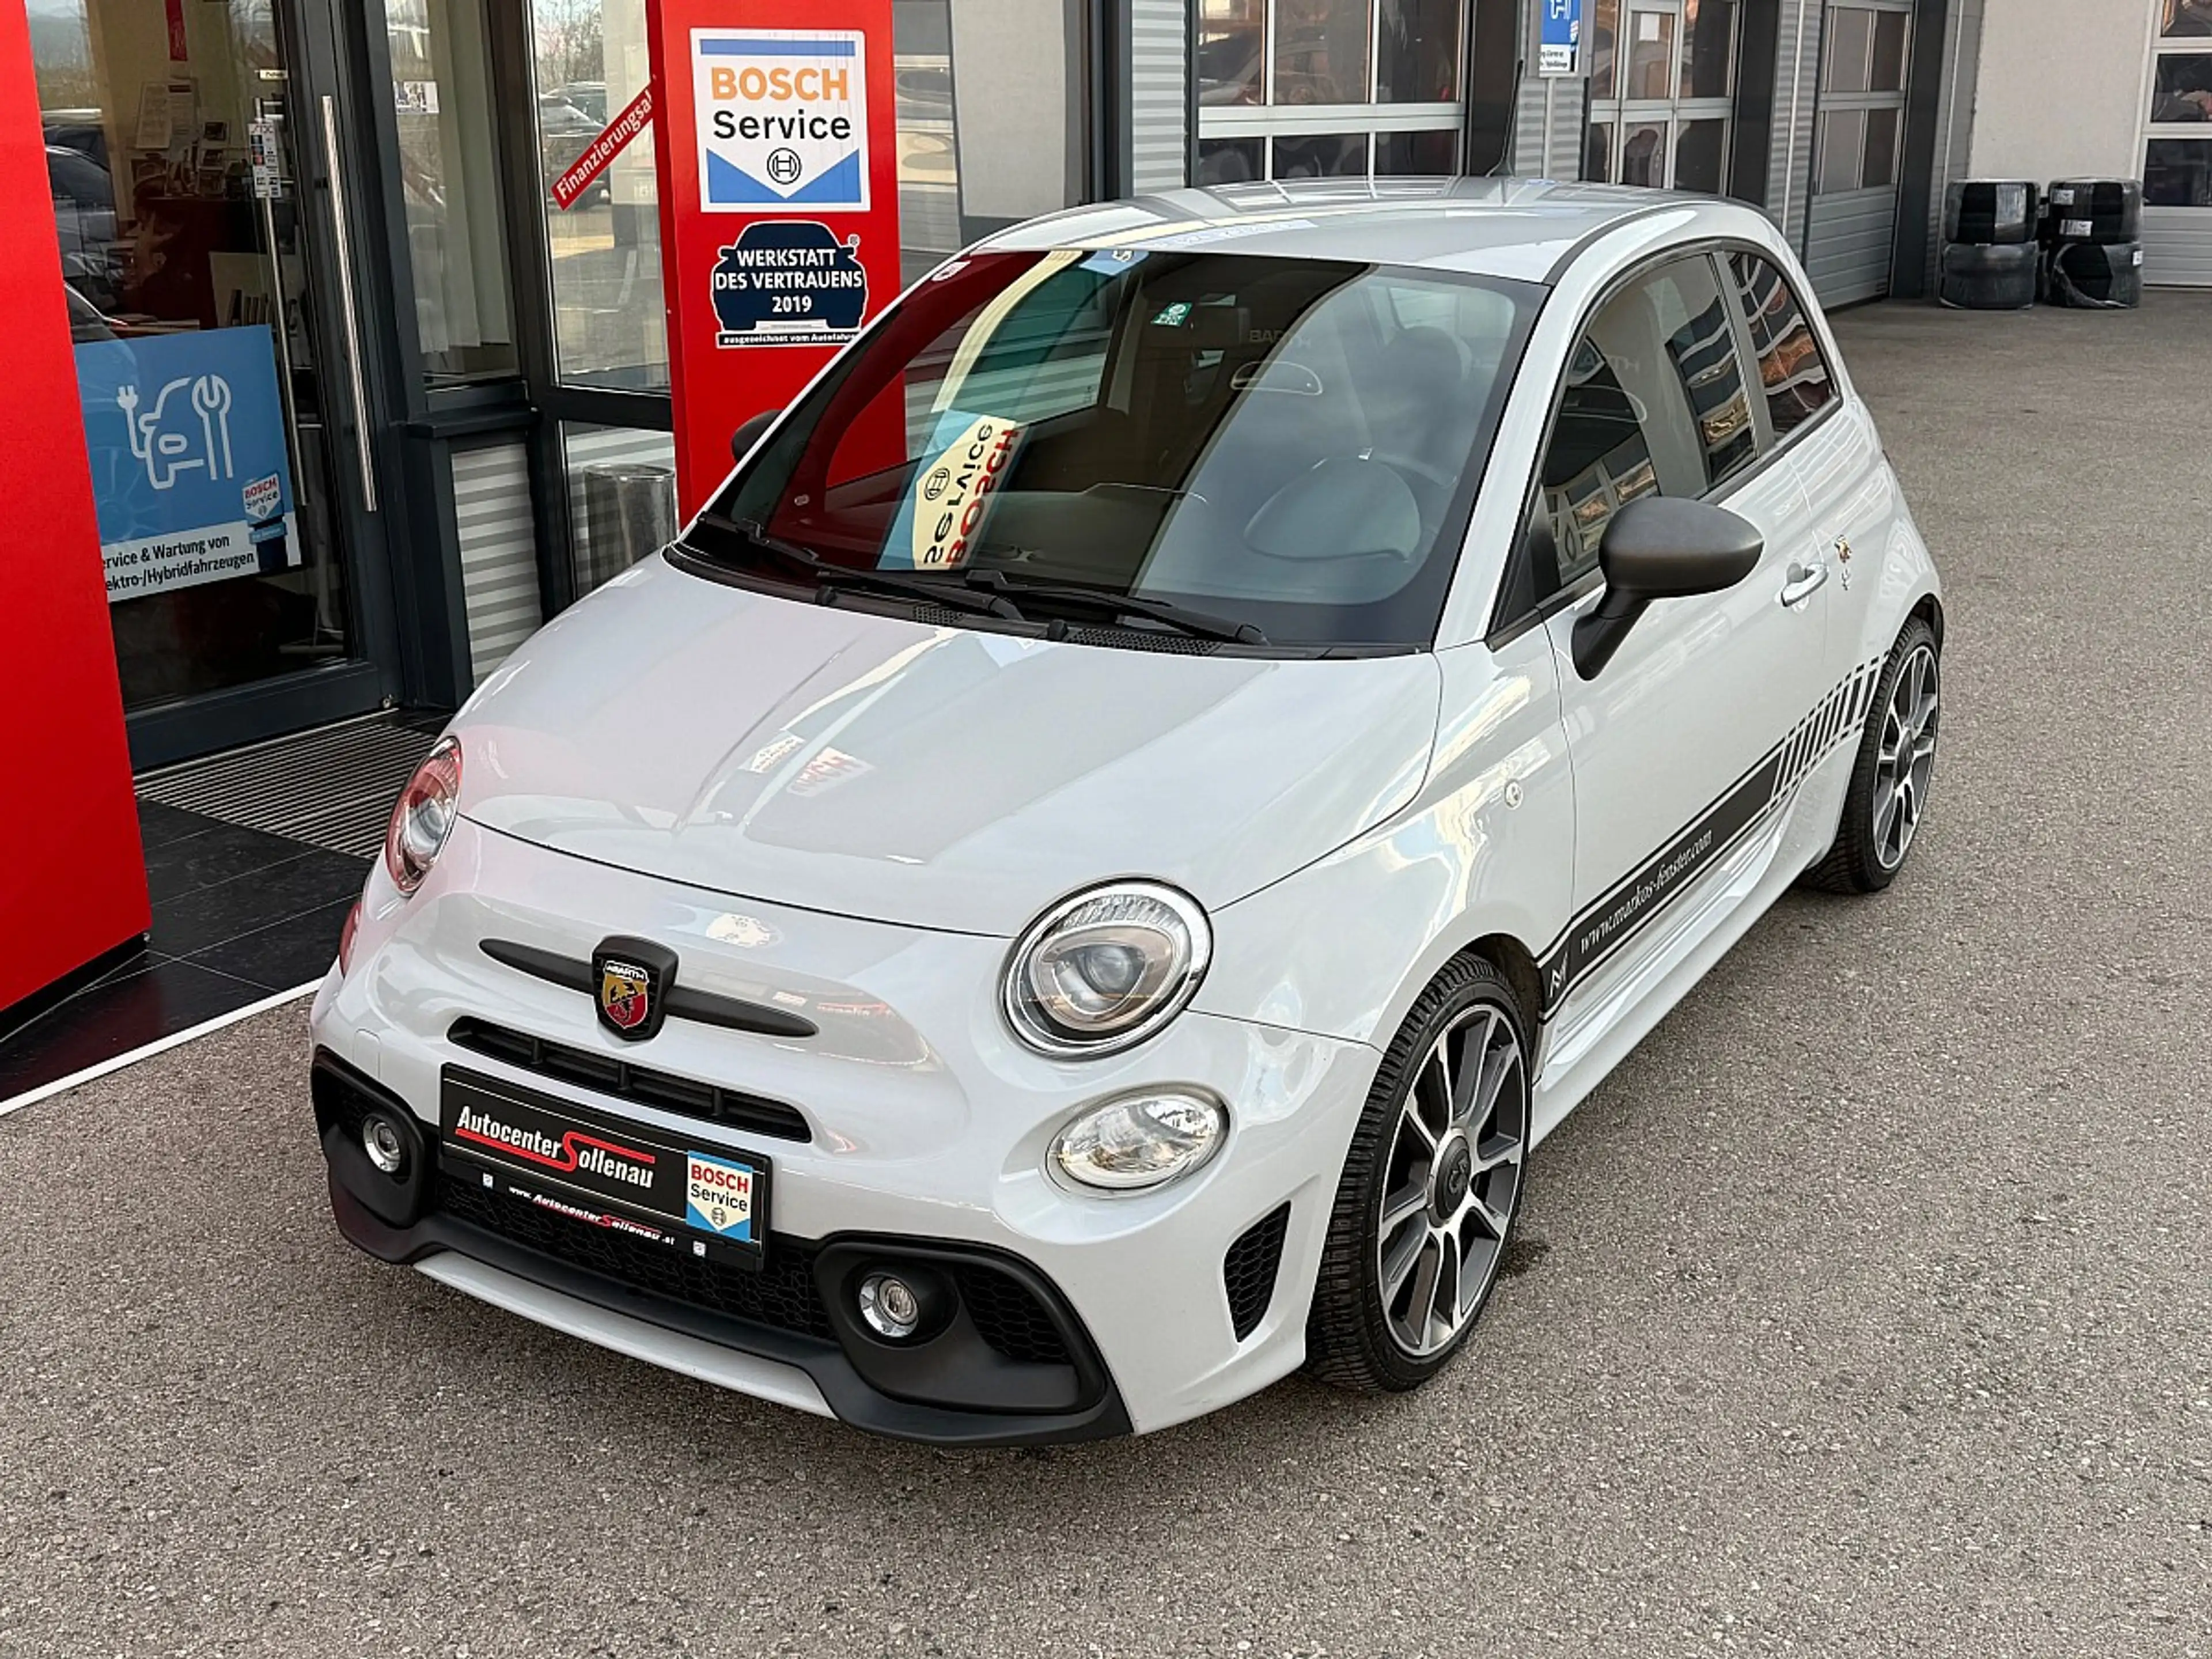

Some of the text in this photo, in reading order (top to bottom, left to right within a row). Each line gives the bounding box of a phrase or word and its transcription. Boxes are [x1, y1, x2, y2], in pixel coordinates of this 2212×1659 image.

[711, 67, 848, 100] BOSCH
[713, 109, 850, 139] Service
[736, 248, 836, 267] WERKSTATT
[715, 270, 863, 290] DES VERTRAUENS
[772, 295, 812, 313] 2019
[245, 477, 277, 499] BOSCH
[246, 491, 278, 510] Service
[141, 547, 150, 562] &
[153, 540, 206, 560] Wartung
[207, 536, 230, 548] von
[691, 1164, 749, 1193] BOSCH
[691, 1183, 748, 1212] Service
